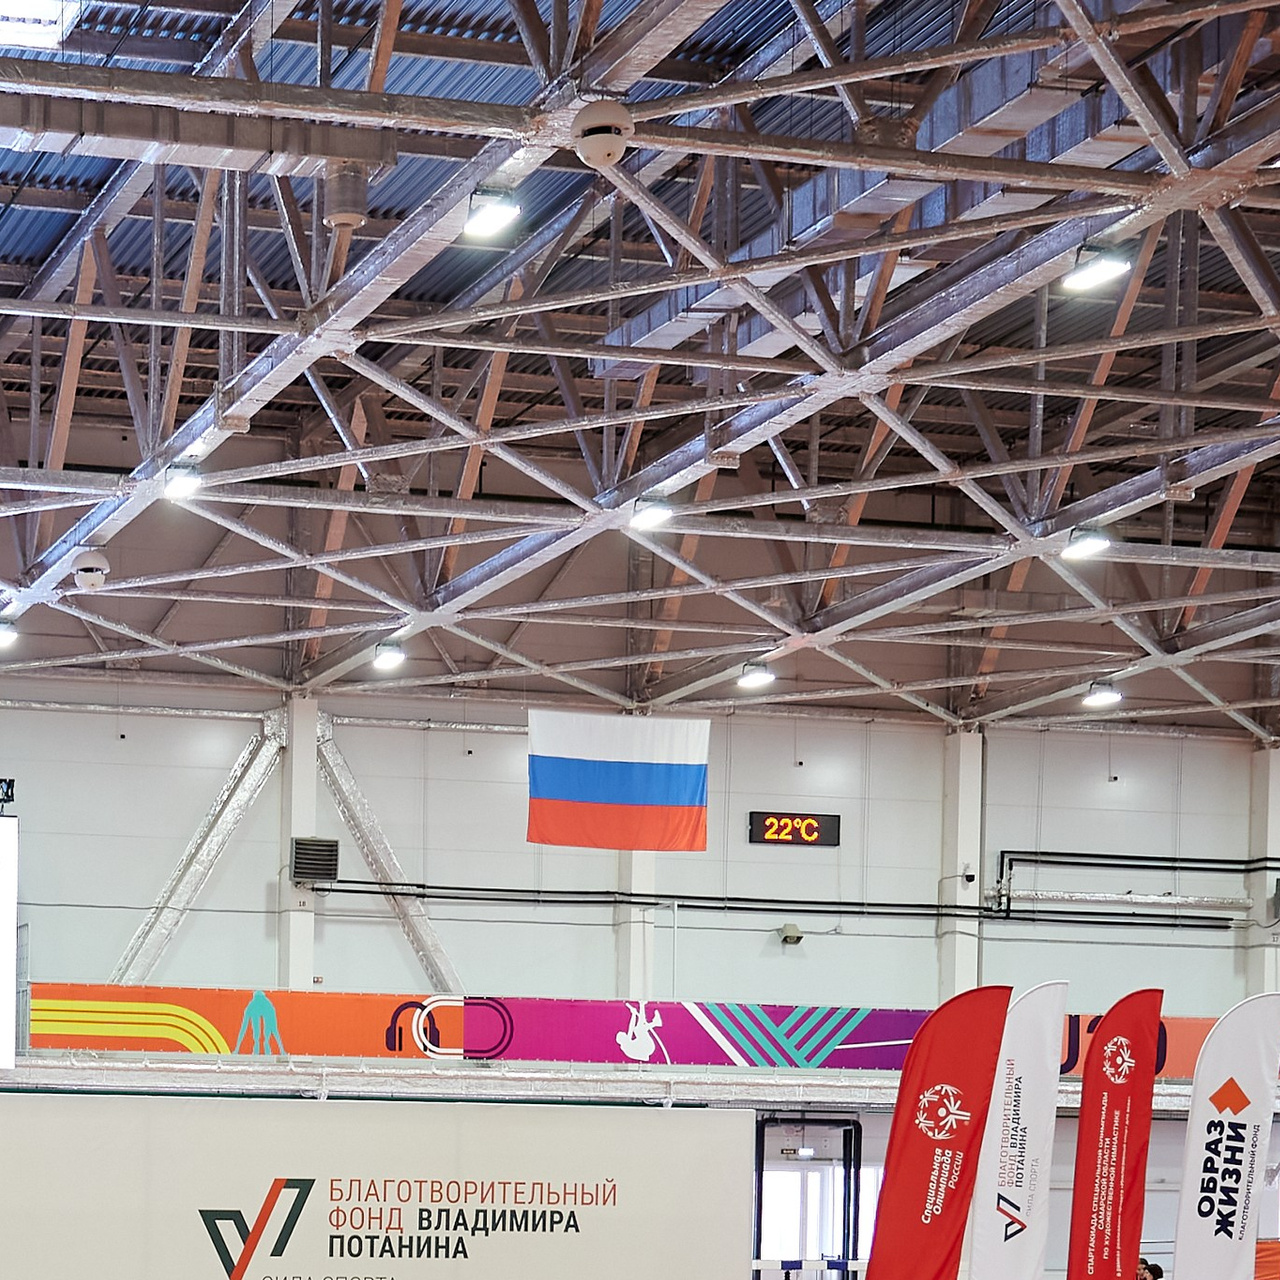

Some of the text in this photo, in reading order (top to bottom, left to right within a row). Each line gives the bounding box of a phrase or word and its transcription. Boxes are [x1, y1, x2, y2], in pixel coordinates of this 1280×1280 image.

[764, 817, 819, 841] 22°C
[998, 1059, 1014, 1186] БЛАГОТВОРИТЕЛЬНЫЙ
[1007, 1077, 1022, 1187] ФОНД ВЛАДИМИРА
[1110, 1111, 1120, 1167] ГИМНАСТИКЕ
[1251, 1125, 1260, 1149] ФОНД
[921, 1148, 944, 1225] Специальная
[932, 1149, 952, 1216] Олимпиада
[948, 1151, 963, 1189] России
[1015, 1127, 1027, 1187] ПОТАНИНА
[1028, 1157, 1039, 1191] СПОРТА
[1091, 1148, 1103, 1213] СПЕЦИАЛЬНОЙ
[1098, 1137, 1111, 1231] САМАРСКОЙ ОБЛАСТИ
[1197, 1119, 1225, 1218] ОБРАЗ
[1214, 1121, 1247, 1240] ЖИЗНИ
[329, 1206, 579, 1236] ФОНД ВЛАДИМИРА
[330, 1177, 617, 1206] БЛАГОТВОРИТЕЛЬНЫЙ
[1104, 1166, 1117, 1247] ХУДОЖЕСТВЕННОЙ
[329, 1235, 468, 1258] ПОТАНИНА
[1087, 1212, 1100, 1276] СПАРТАКИАДА
